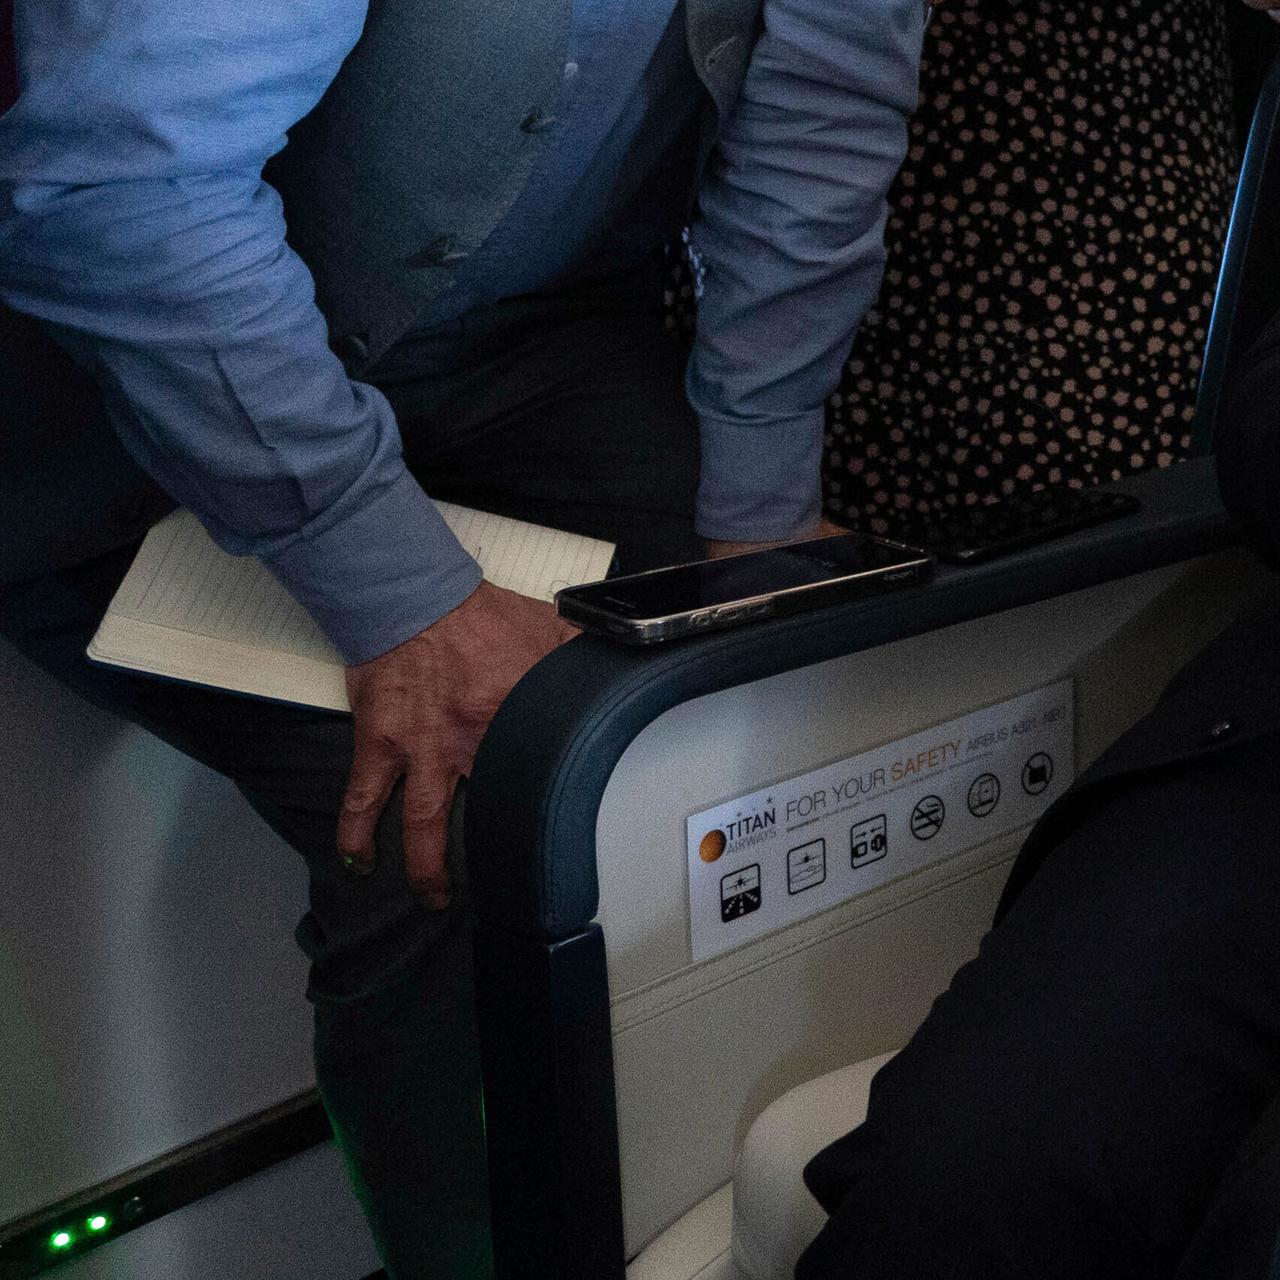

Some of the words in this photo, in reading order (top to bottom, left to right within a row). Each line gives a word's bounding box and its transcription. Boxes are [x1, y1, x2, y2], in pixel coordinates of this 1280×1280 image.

[786, 790, 827, 821] FOR
[832, 768, 885, 803] YOUR
[891, 739, 961, 782] SAFETY
[966, 726, 1009, 752] AIRBUS
[726, 807, 776, 841] TITAN
[727, 828, 777, 854] AIRWAYS
